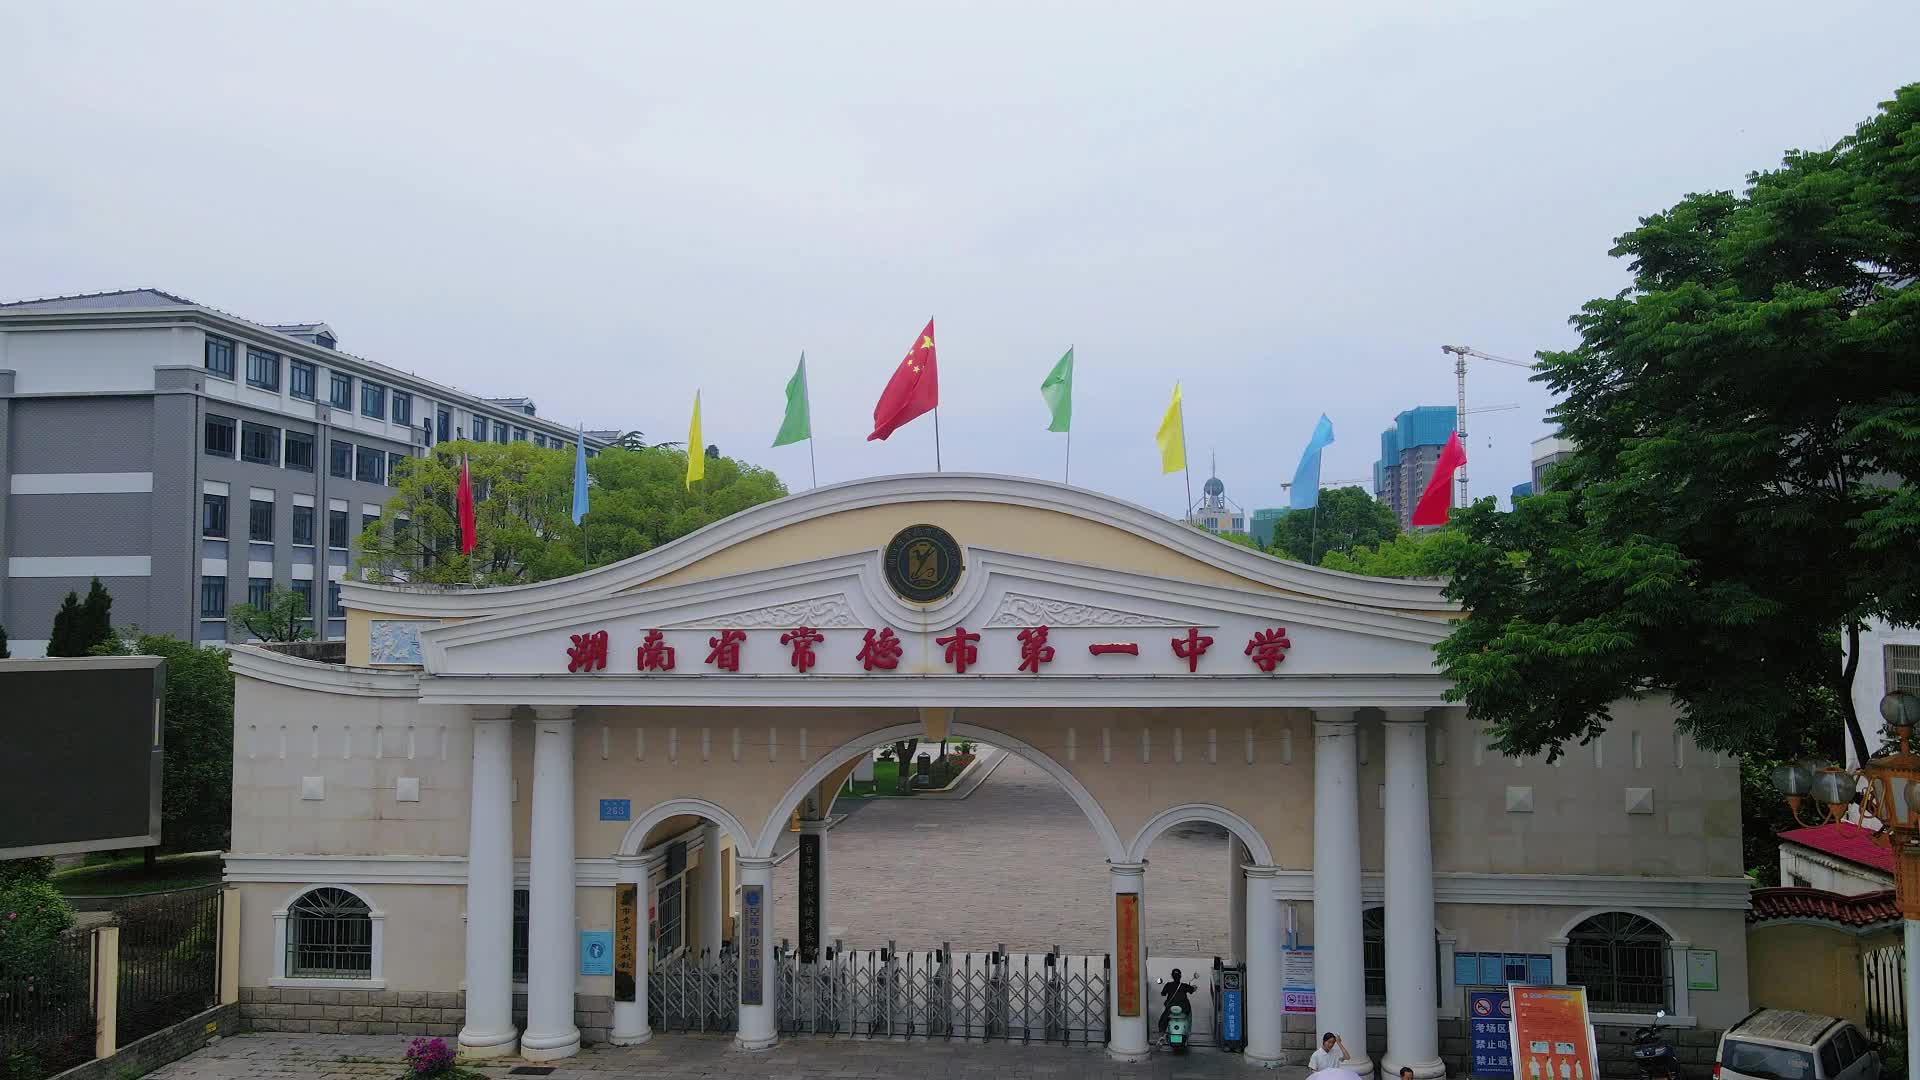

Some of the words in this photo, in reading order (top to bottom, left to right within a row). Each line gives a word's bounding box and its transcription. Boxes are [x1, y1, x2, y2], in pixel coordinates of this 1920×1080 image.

[566, 625, 1291, 674] 湖南省常德市第一中学
[1475, 1023, 1509, 1034] 考场区
[1475, 1040, 1511, 1050] 禁止鸣
